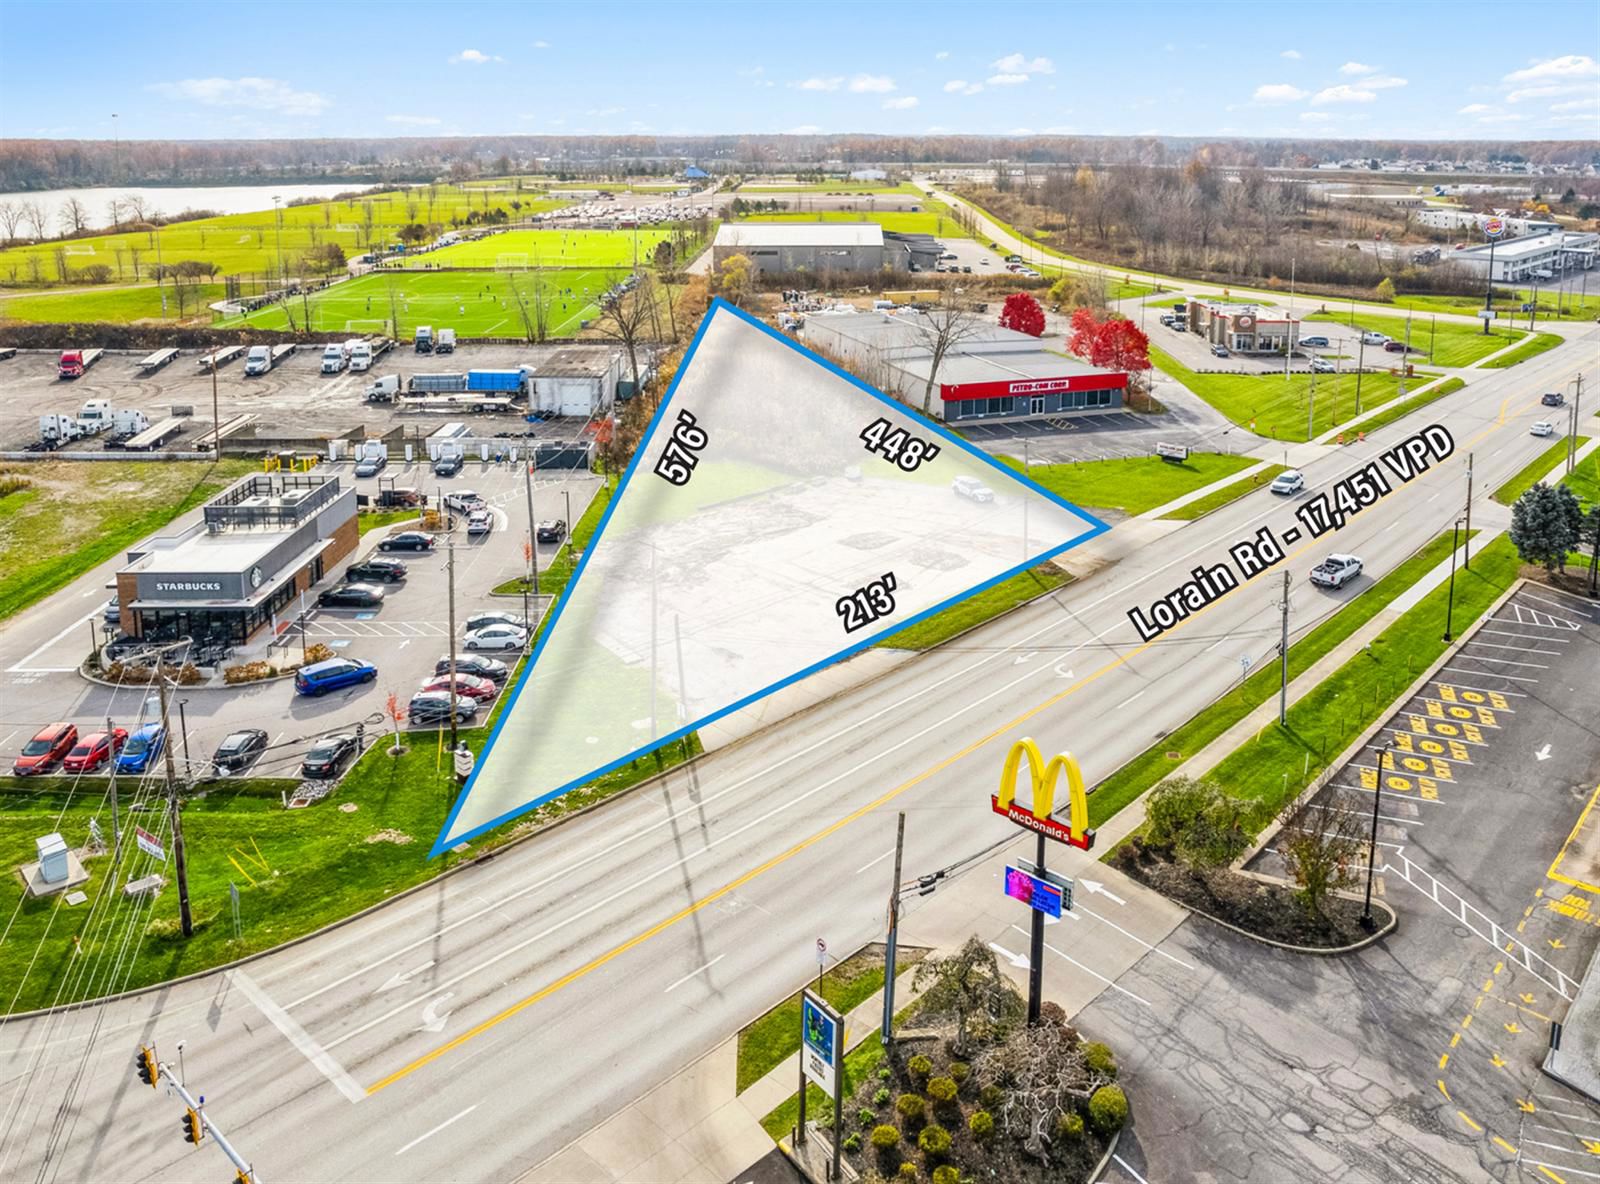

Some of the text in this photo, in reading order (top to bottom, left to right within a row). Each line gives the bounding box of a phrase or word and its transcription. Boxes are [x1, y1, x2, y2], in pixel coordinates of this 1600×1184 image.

[1012, 383, 1049, 392] PETRO-COM
[156, 582, 221, 591] STARBUCKS
[1009, 809, 1069, 842] McDonald's
